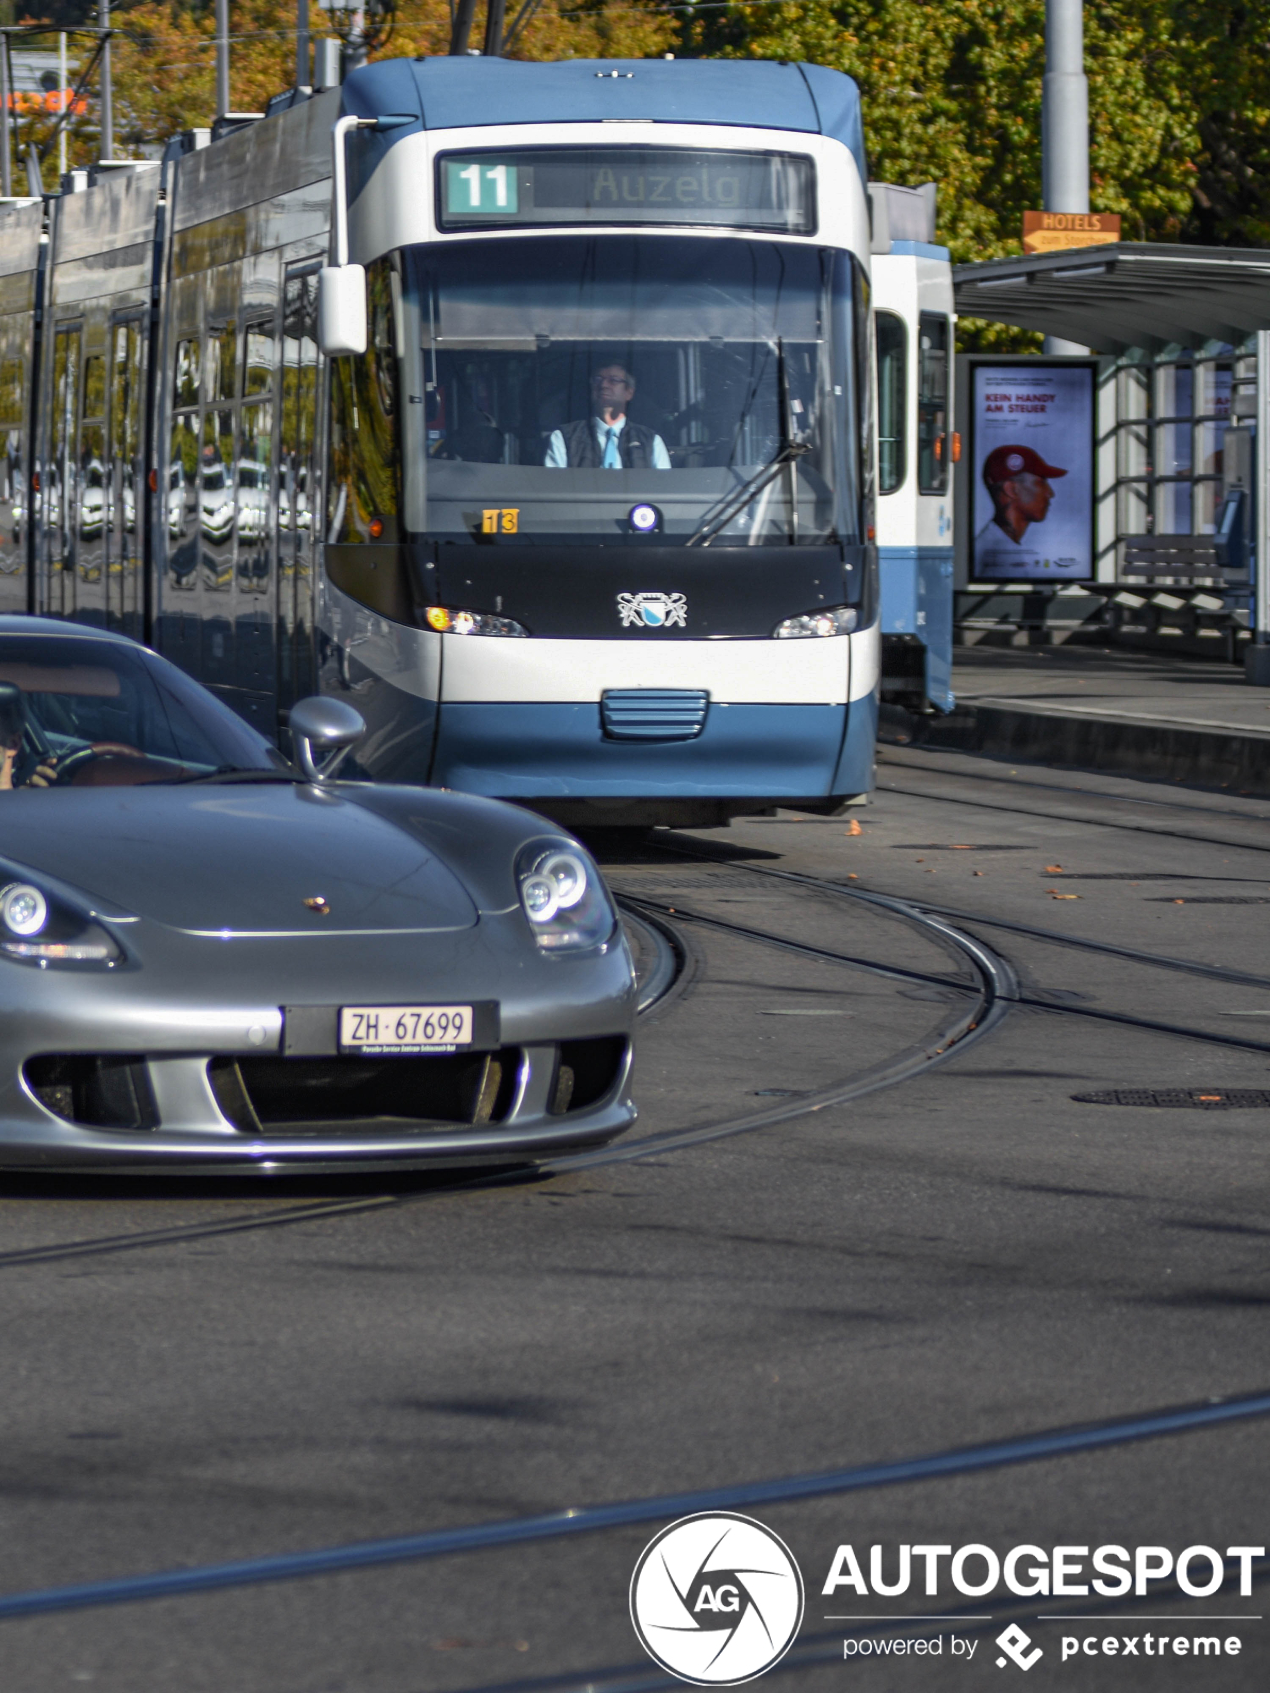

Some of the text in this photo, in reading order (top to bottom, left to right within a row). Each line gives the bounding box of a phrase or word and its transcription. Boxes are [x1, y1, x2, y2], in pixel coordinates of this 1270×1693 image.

[459, 164, 740, 207] 11 Auzelg
[1042, 214, 1102, 230] HOTELS
[984, 393, 1056, 403] KEIN HANDY
[984, 404, 1047, 413] AM STEUER
[485, 511, 517, 533] 13
[351, 1012, 464, 1041] ZH 67699
